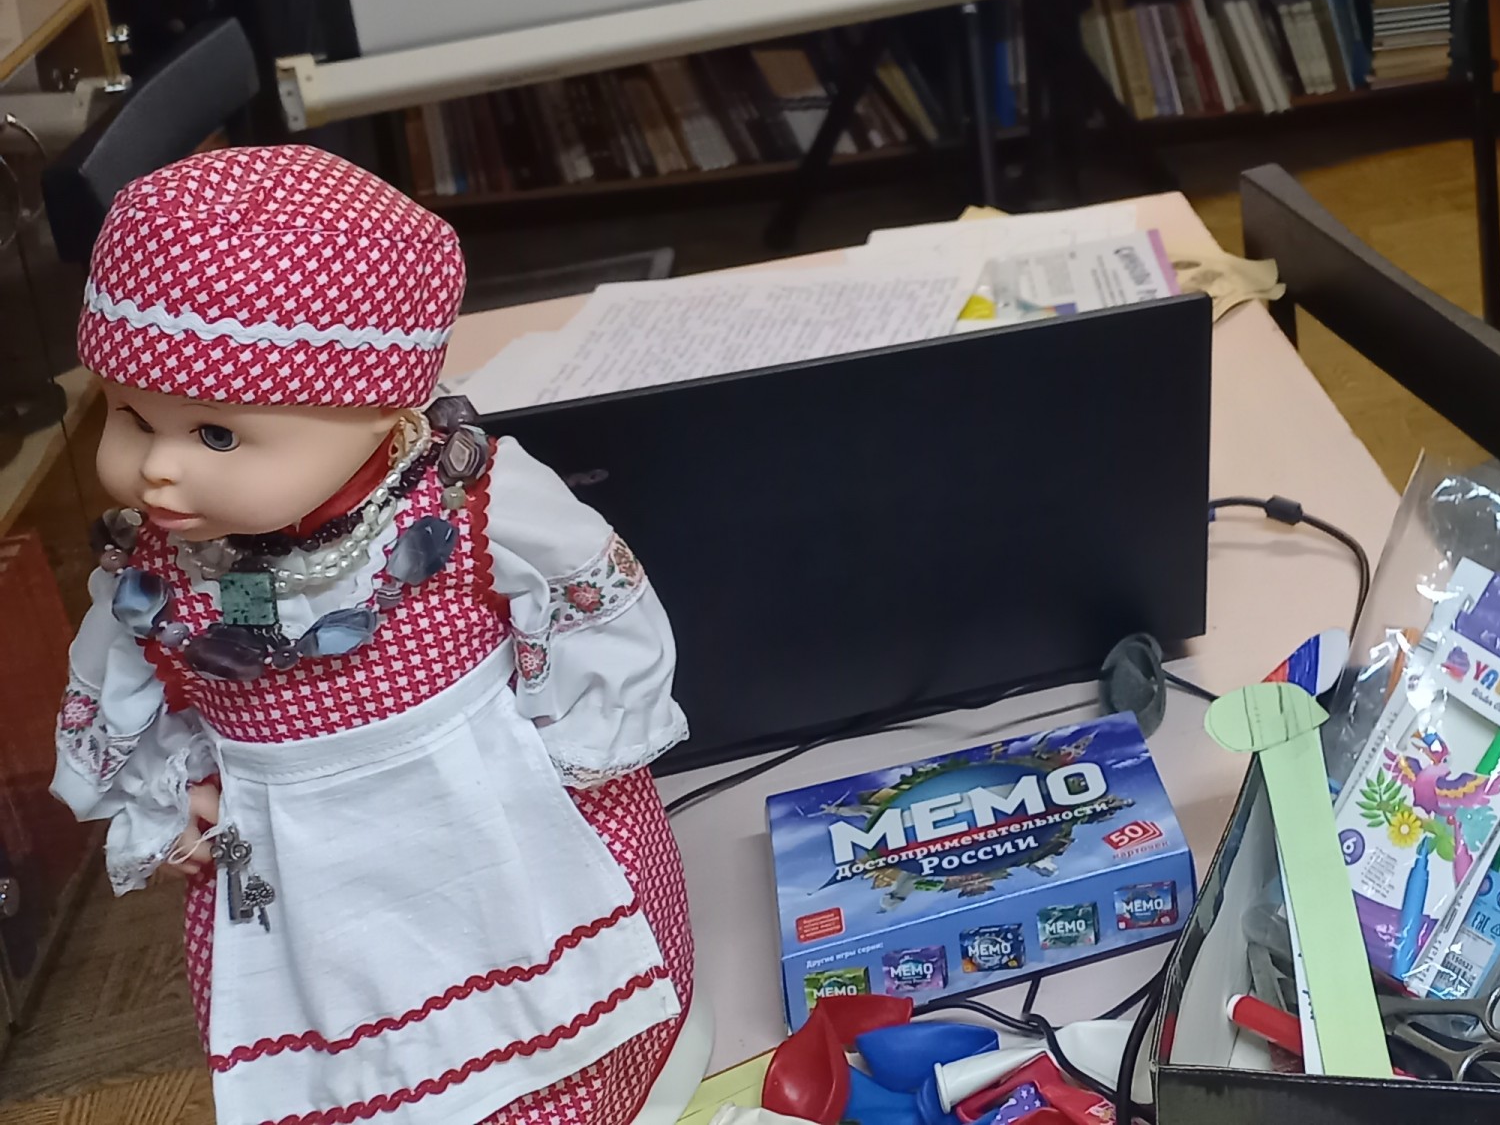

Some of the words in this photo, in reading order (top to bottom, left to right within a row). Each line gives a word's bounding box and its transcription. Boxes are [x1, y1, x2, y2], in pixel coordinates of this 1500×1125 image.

[836, 800, 1109, 881] Достопримечательности
[922, 832, 1039, 875] России
[1109, 824, 1143, 850] 50
